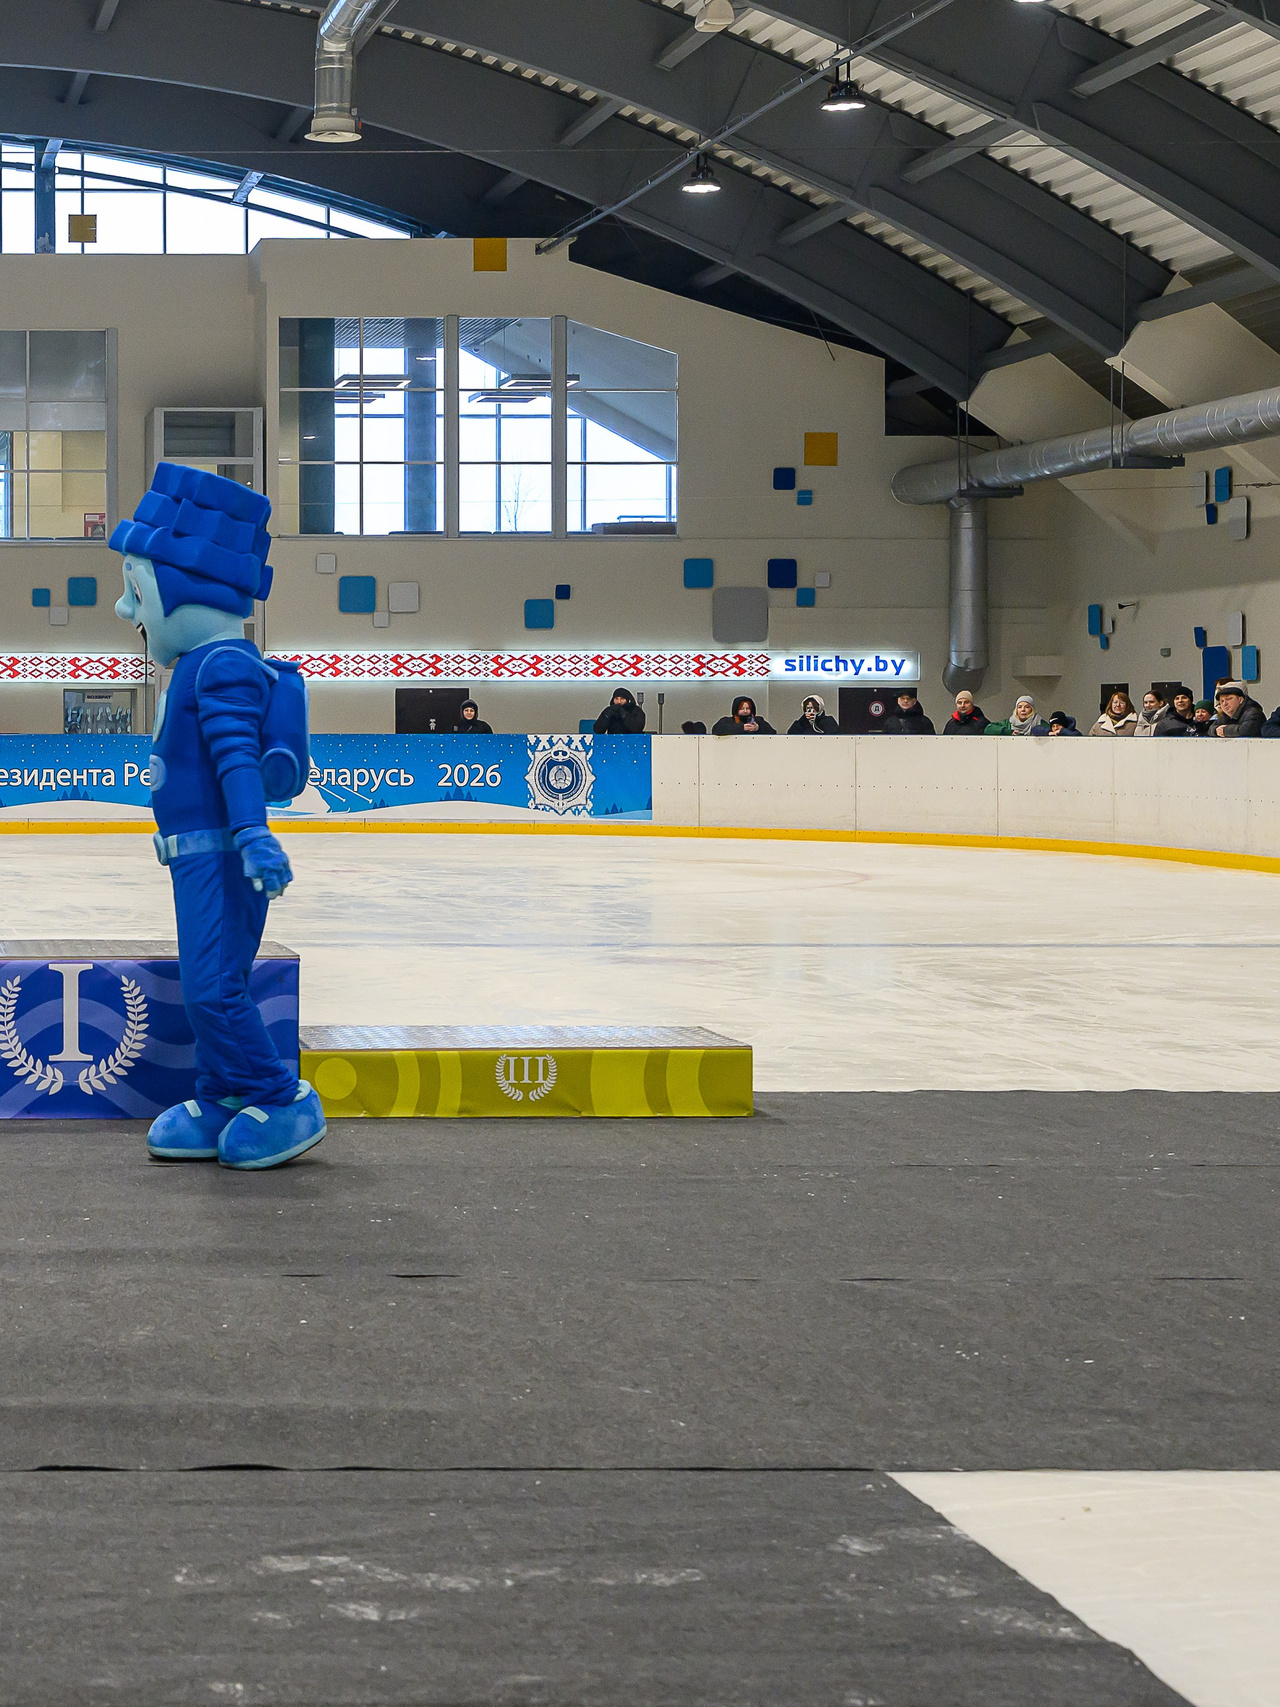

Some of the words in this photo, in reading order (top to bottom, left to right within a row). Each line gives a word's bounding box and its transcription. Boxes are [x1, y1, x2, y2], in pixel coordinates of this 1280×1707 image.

[784, 655, 906, 676] silichy.by
[307, 767, 415, 793] еларусь
[437, 763, 503, 788] 2026
[48, 963, 94, 1062] I
[506, 1056, 547, 1083] III
